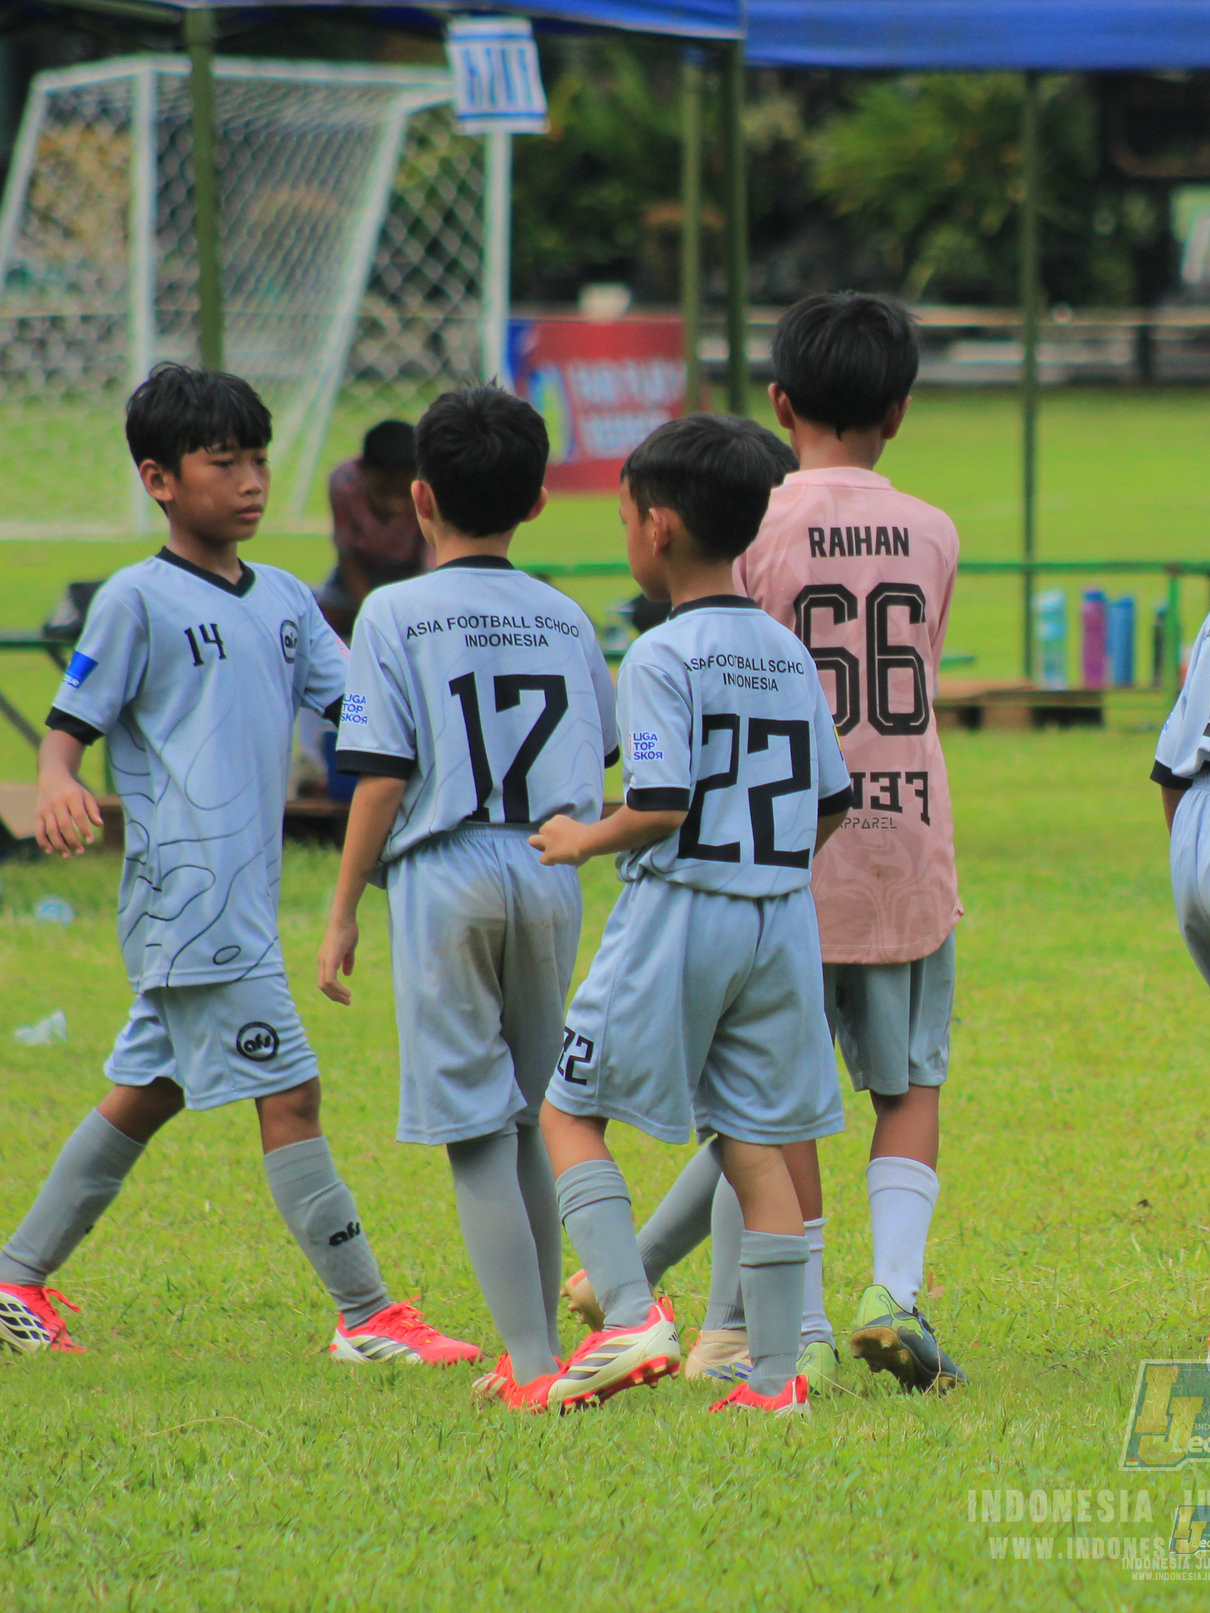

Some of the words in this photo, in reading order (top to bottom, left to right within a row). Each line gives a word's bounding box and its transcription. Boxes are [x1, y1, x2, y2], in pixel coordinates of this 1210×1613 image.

[808, 526, 910, 558] RAIHAN
[406, 619, 443, 640] ASIA
[447, 615, 531, 631] FOOTBALL
[535, 616, 580, 638] SCHOO
[184, 623, 228, 667] 14
[464, 633, 550, 648] INDONESIA
[708, 654, 767, 671] FOOBALL
[769, 660, 804, 675] SCHO
[793, 582, 930, 736] 66
[722, 672, 779, 691] INONESIA
[448, 671, 569, 823] 17
[633, 732, 658, 742] LIGA
[633, 742, 656, 751] TOP
[676, 713, 812, 869] 22
